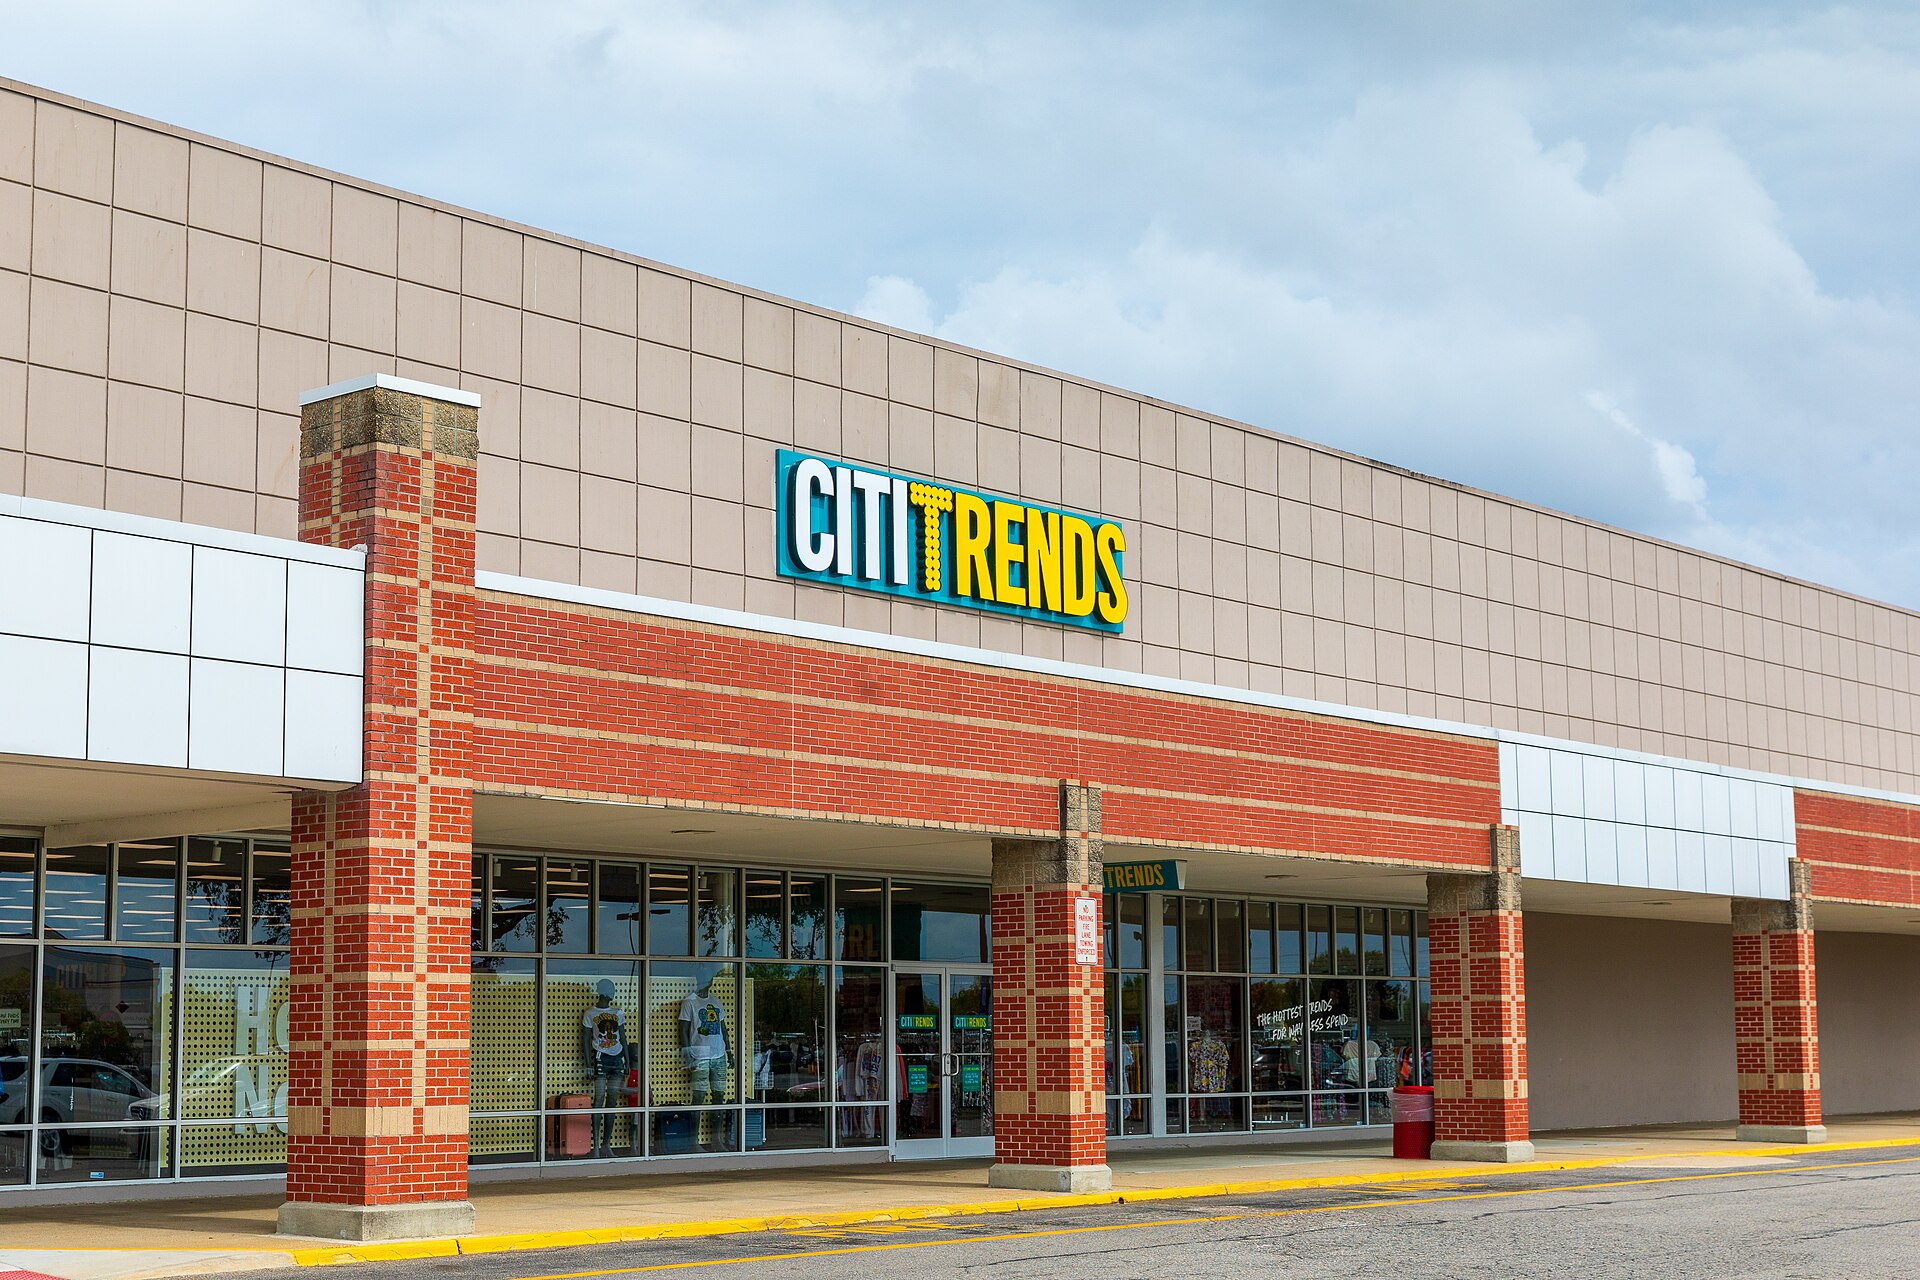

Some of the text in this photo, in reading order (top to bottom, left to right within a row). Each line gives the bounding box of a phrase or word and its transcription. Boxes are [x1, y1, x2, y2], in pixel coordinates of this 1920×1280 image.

[1078, 914, 1094, 922] PARKING
[1081, 931, 1092, 939] LANE
[1079, 939, 1094, 947] TOWING
[1077, 948, 1096, 956] ENFORCED
[1256, 1012, 1271, 1026] THE
[1272, 1005, 1304, 1023] HOTTEST
[1272, 1013, 1349, 1041] FOR WAY ESS SPEND
